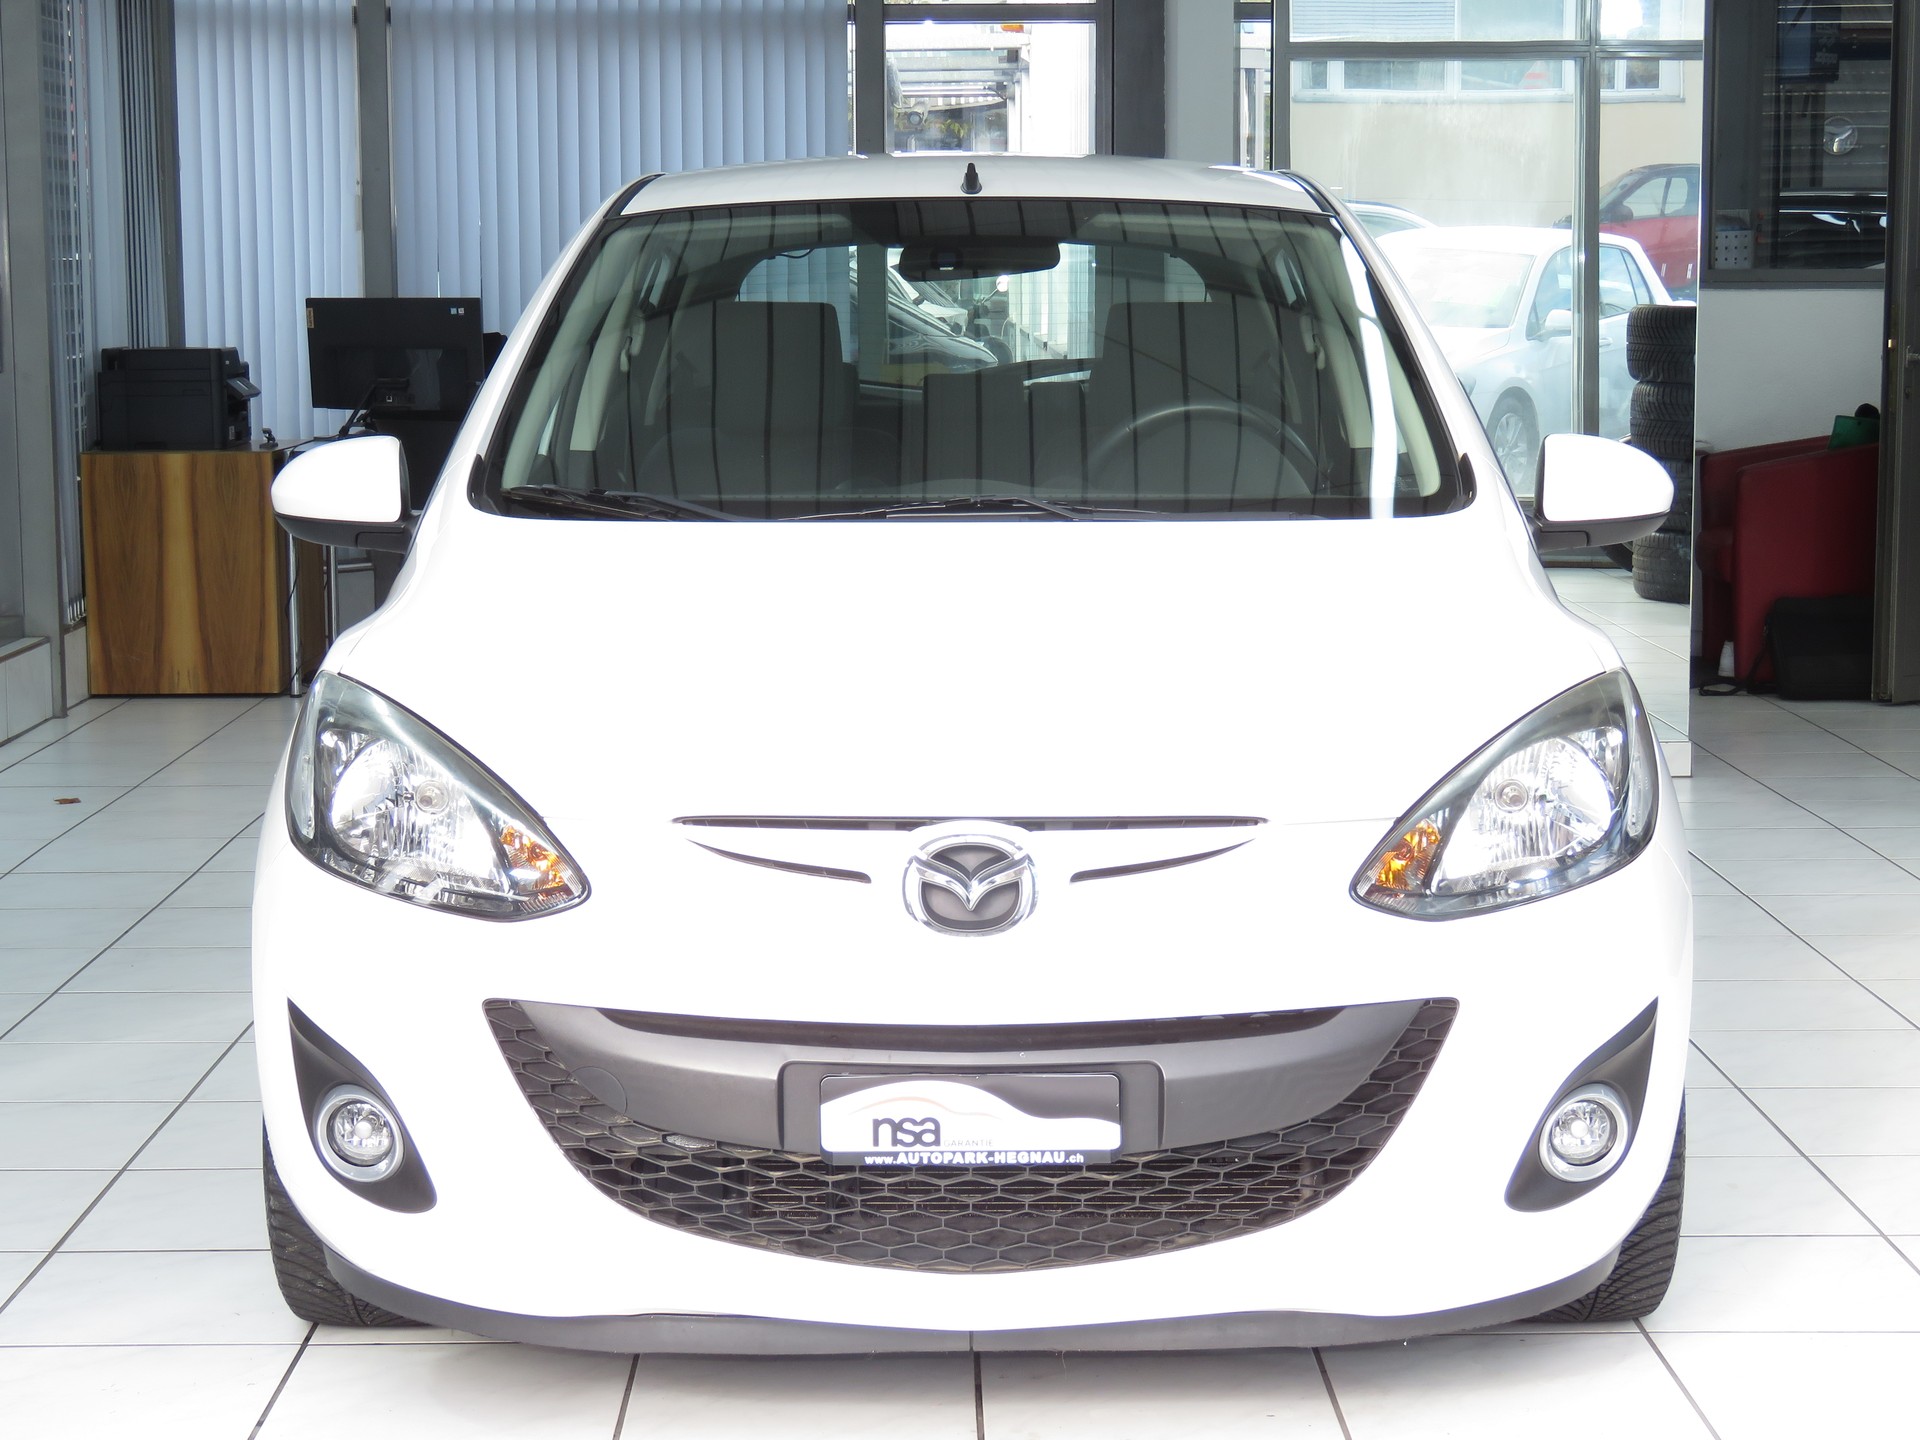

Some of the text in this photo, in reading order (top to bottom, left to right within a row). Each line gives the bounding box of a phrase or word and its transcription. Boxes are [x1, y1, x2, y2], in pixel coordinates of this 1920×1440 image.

[873, 1117, 993, 1148] nsa GARANTIE
[864, 1151, 1084, 1165] www.AUTOPARK-HEGNAU.ch
